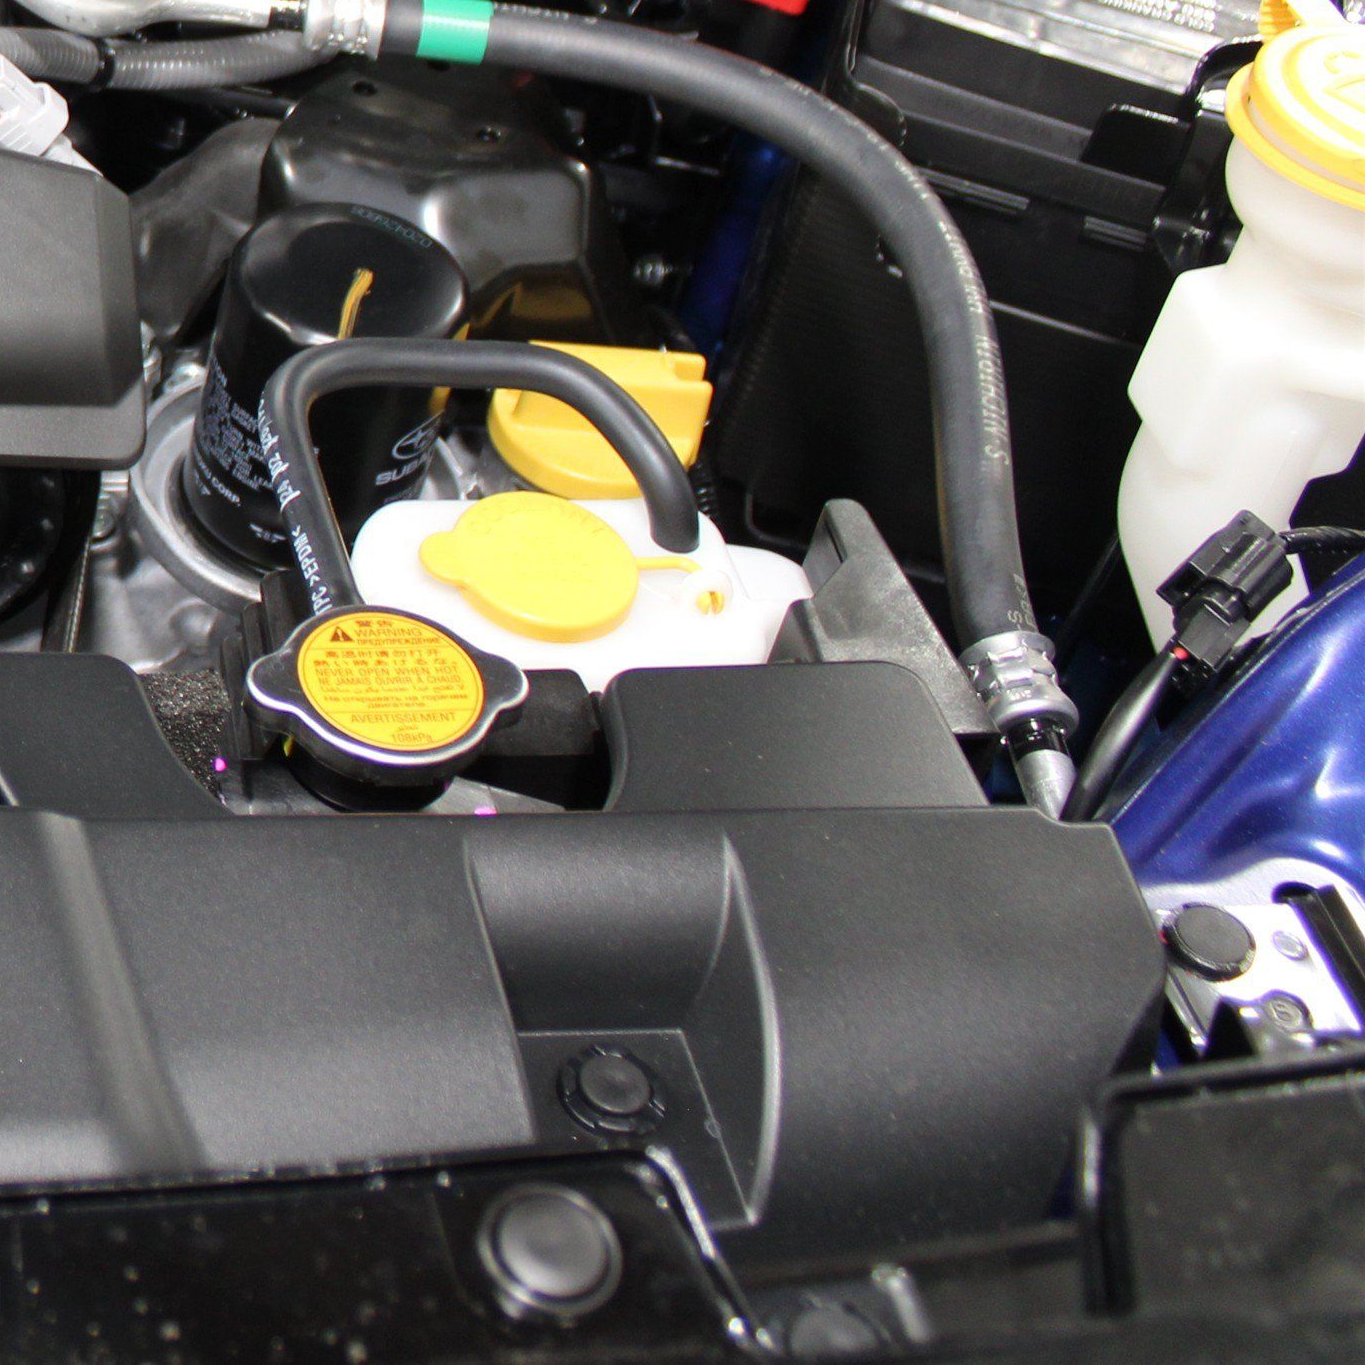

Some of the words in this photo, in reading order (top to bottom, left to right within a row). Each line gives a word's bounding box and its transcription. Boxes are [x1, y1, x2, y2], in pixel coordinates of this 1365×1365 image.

[354, 627, 422, 637] WARNING
[315, 667, 353, 677] NEVER
[358, 667, 390, 676] OPEN
[395, 666, 431, 675] WHEN
[435, 665, 460, 675] HOT
[350, 711, 456, 723] AVERTISSEMENT
[390, 732, 433, 743] 108kPa
